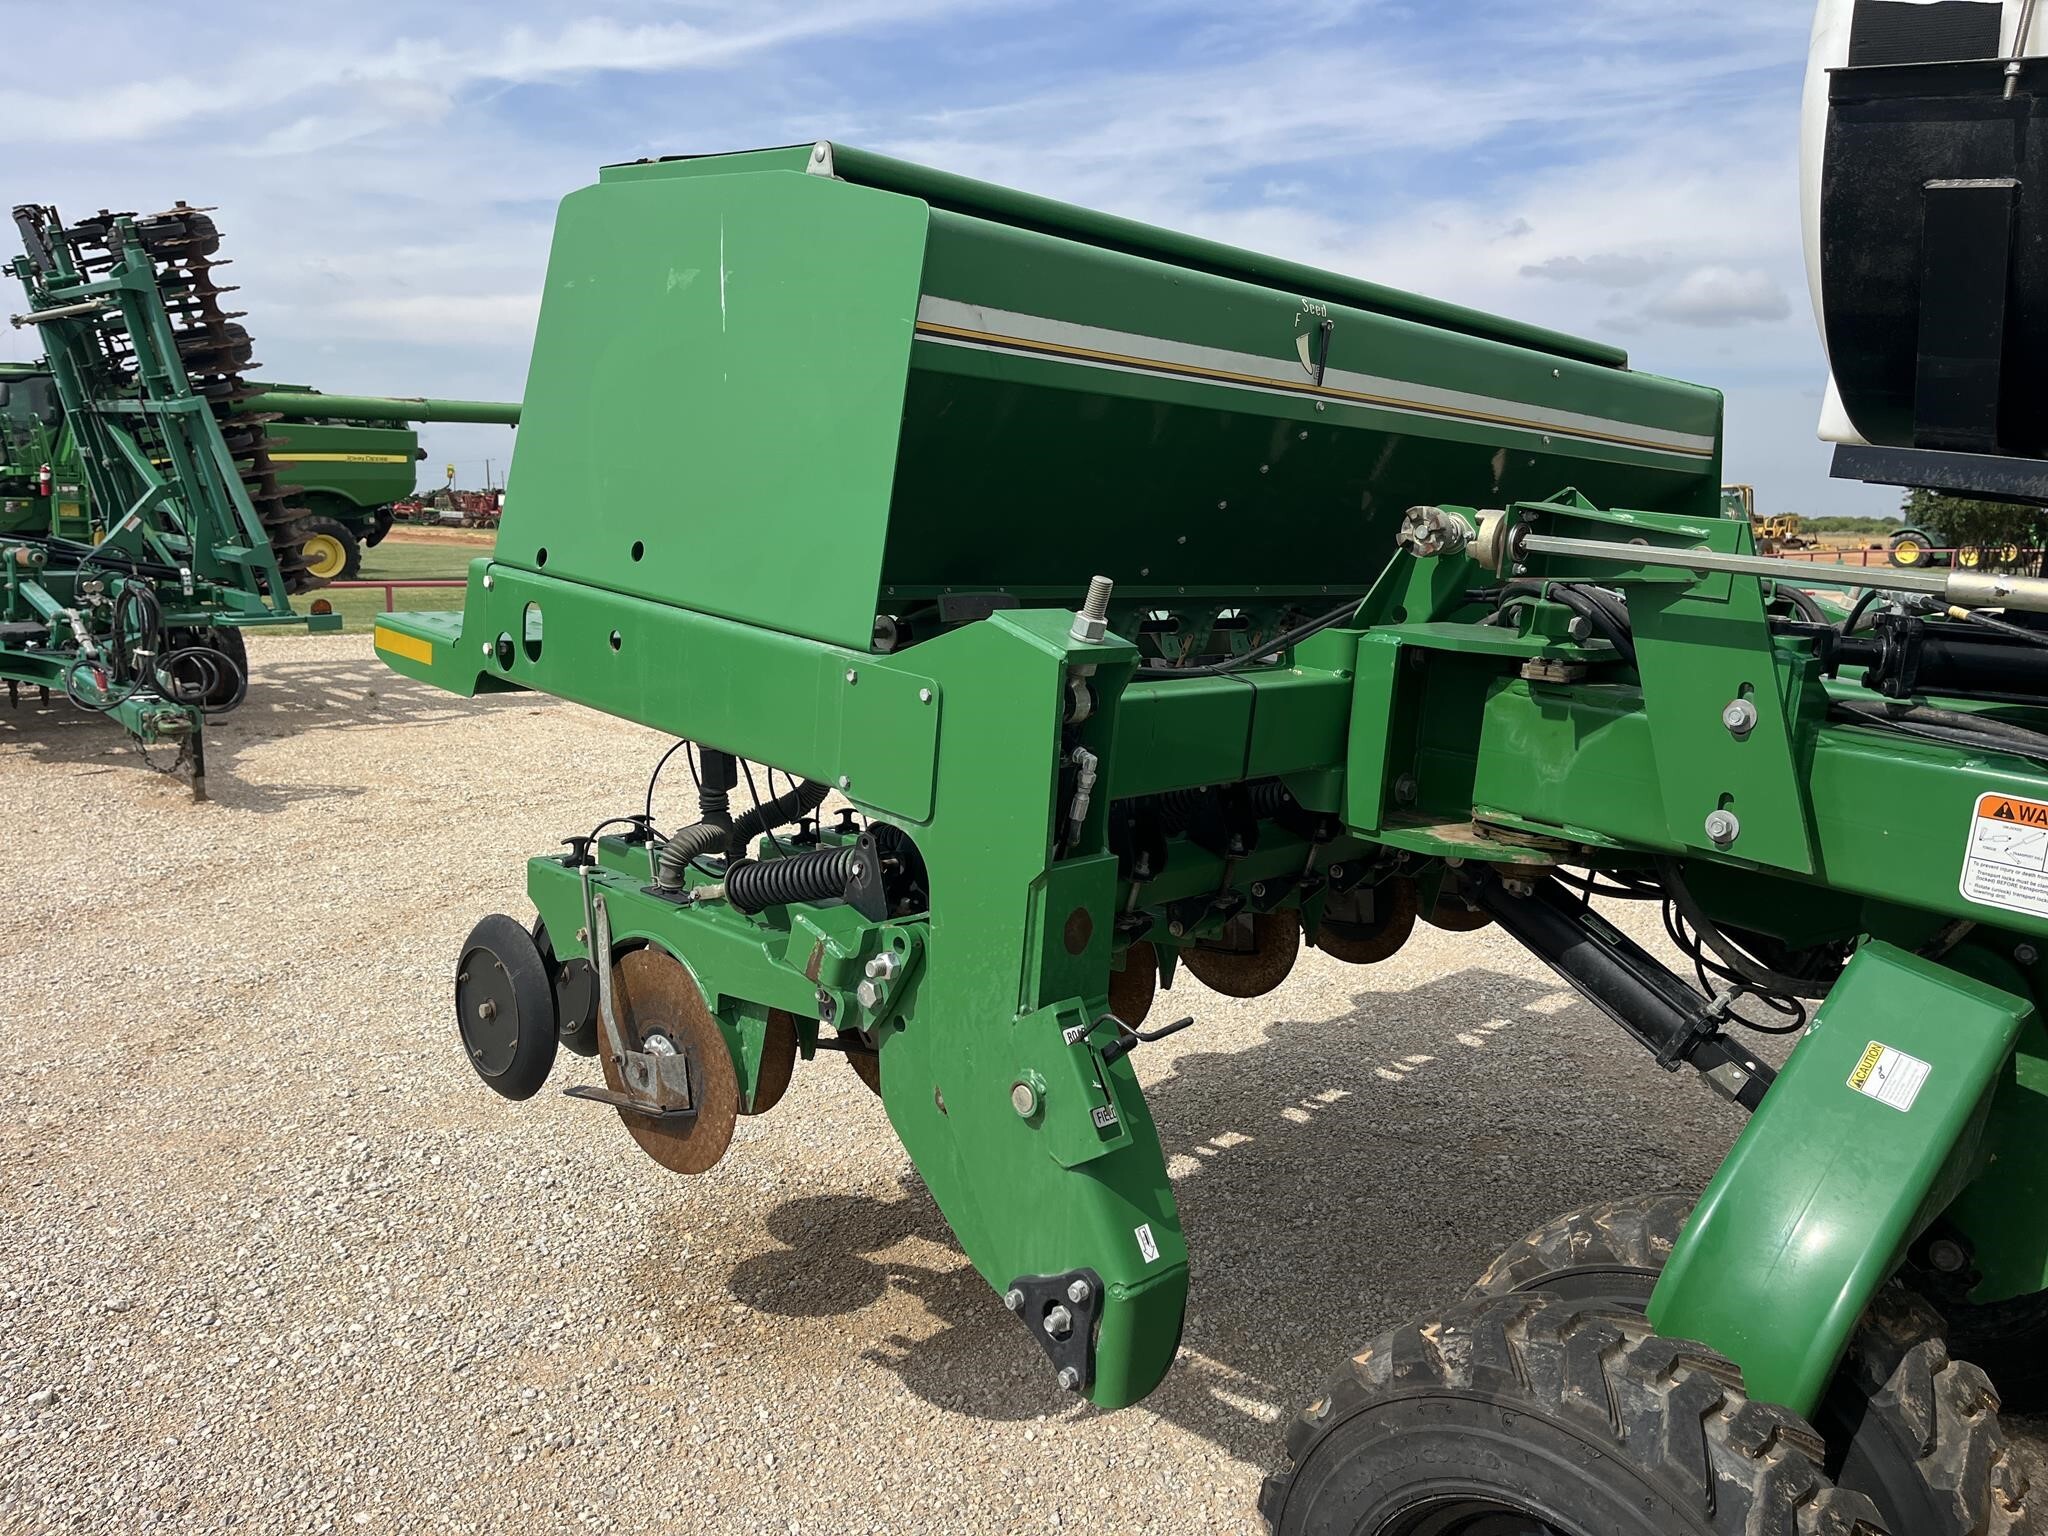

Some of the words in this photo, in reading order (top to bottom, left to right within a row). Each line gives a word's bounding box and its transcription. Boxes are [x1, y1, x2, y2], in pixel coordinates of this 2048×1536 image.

[1302, 297, 1327, 317] Seed
[1294, 312, 1301, 328] F
[1980, 862, 1999, 870] prevent
[1977, 869, 2001, 878] Transport
[1996, 880, 2018, 888] BEFORE
[1973, 888, 1994, 898] lowering
[2012, 891, 2036, 900] transport
[1855, 1043, 1882, 1080] CAUTION
